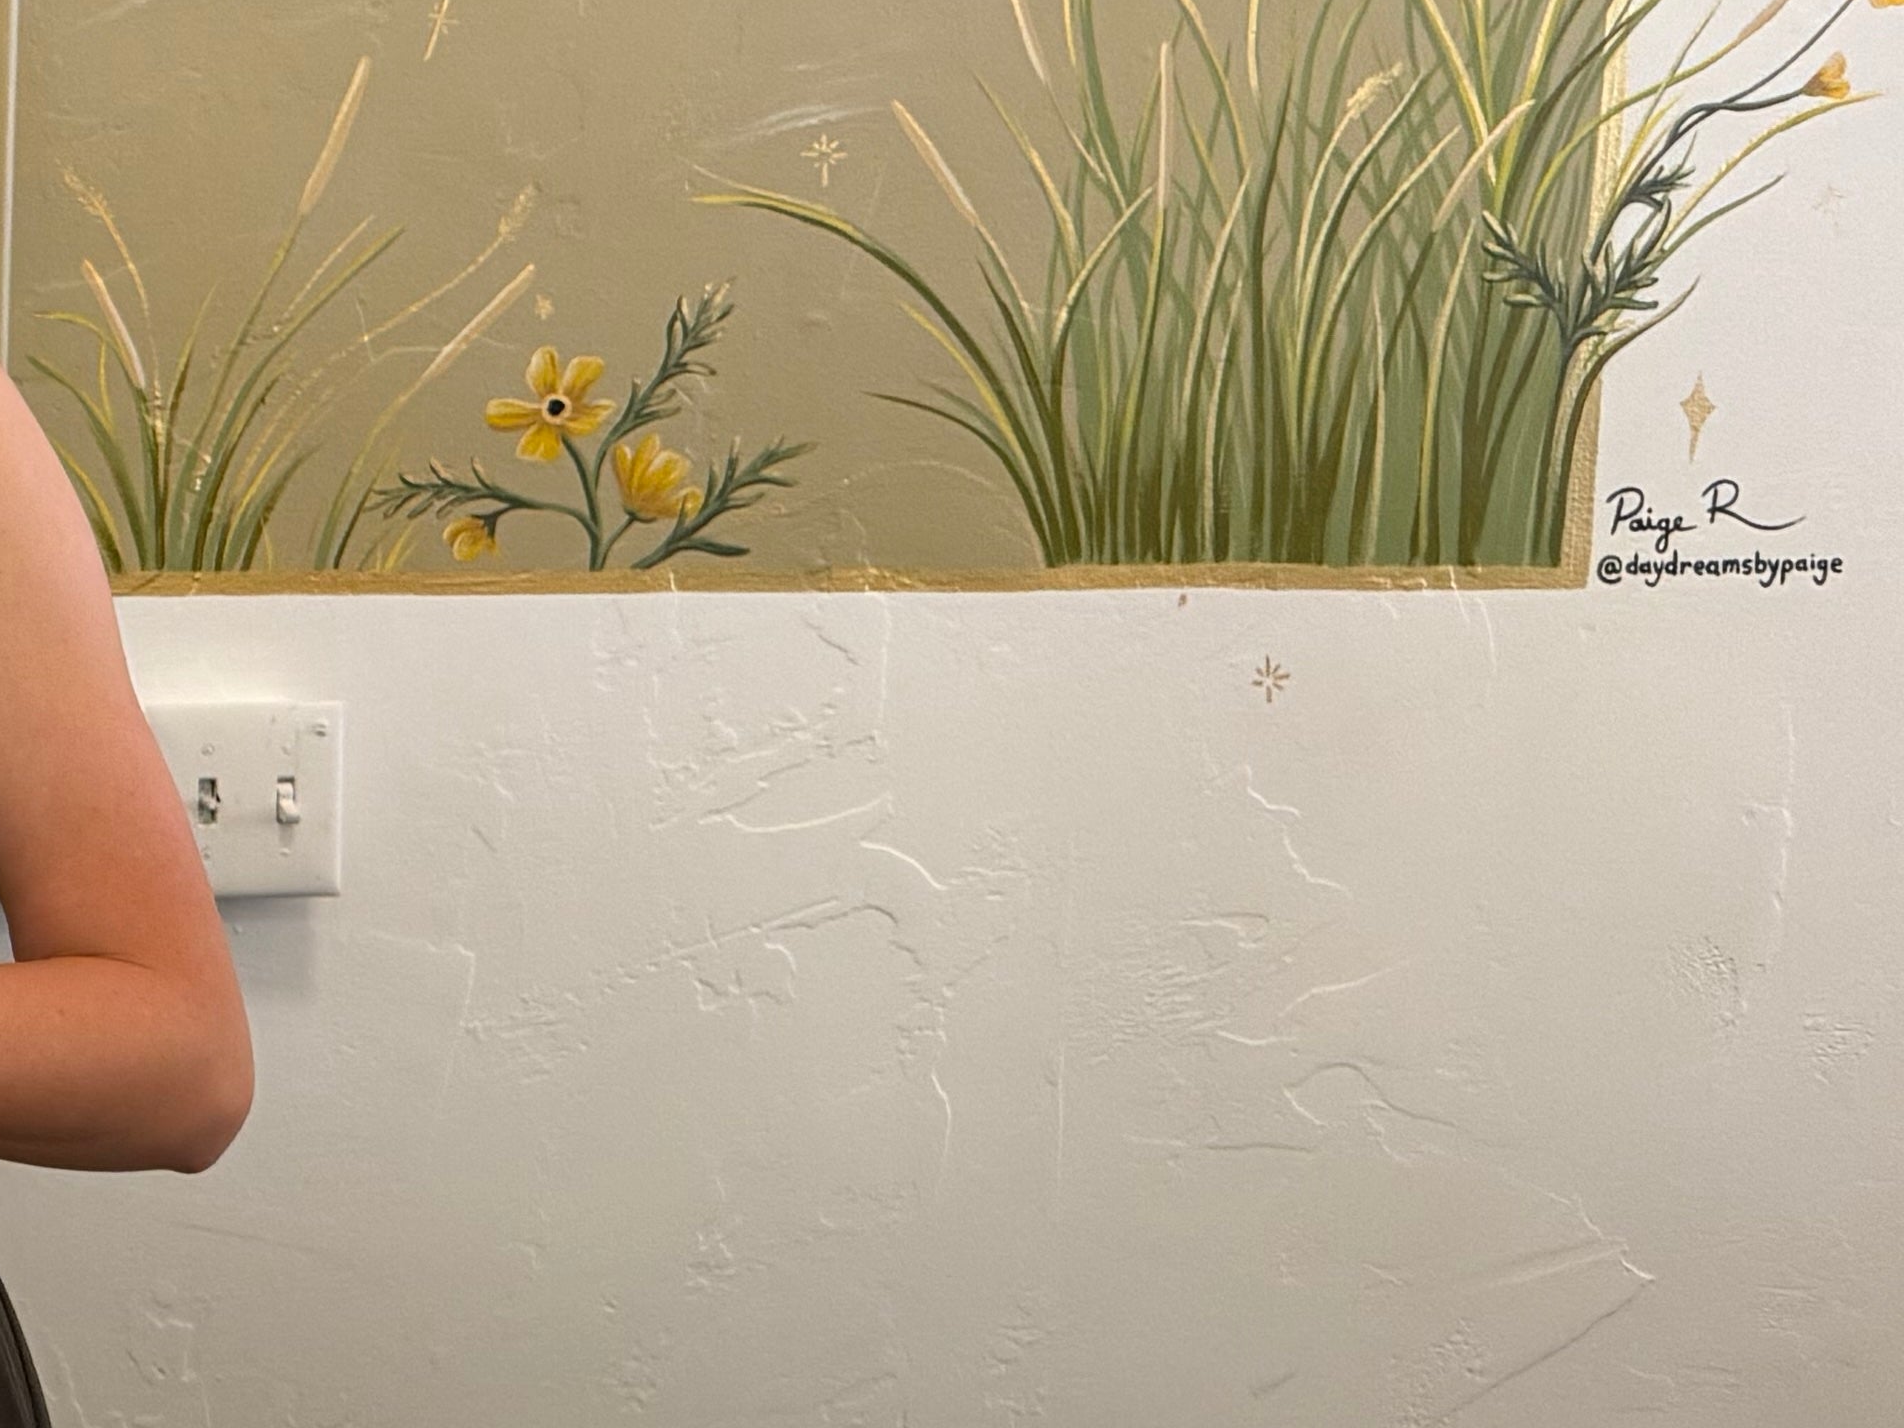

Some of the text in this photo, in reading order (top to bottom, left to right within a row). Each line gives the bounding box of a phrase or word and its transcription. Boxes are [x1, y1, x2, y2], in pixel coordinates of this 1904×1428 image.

[1605, 478, 1807, 554] Paige R
[1596, 549, 1845, 589] @daydreamsbypaige
